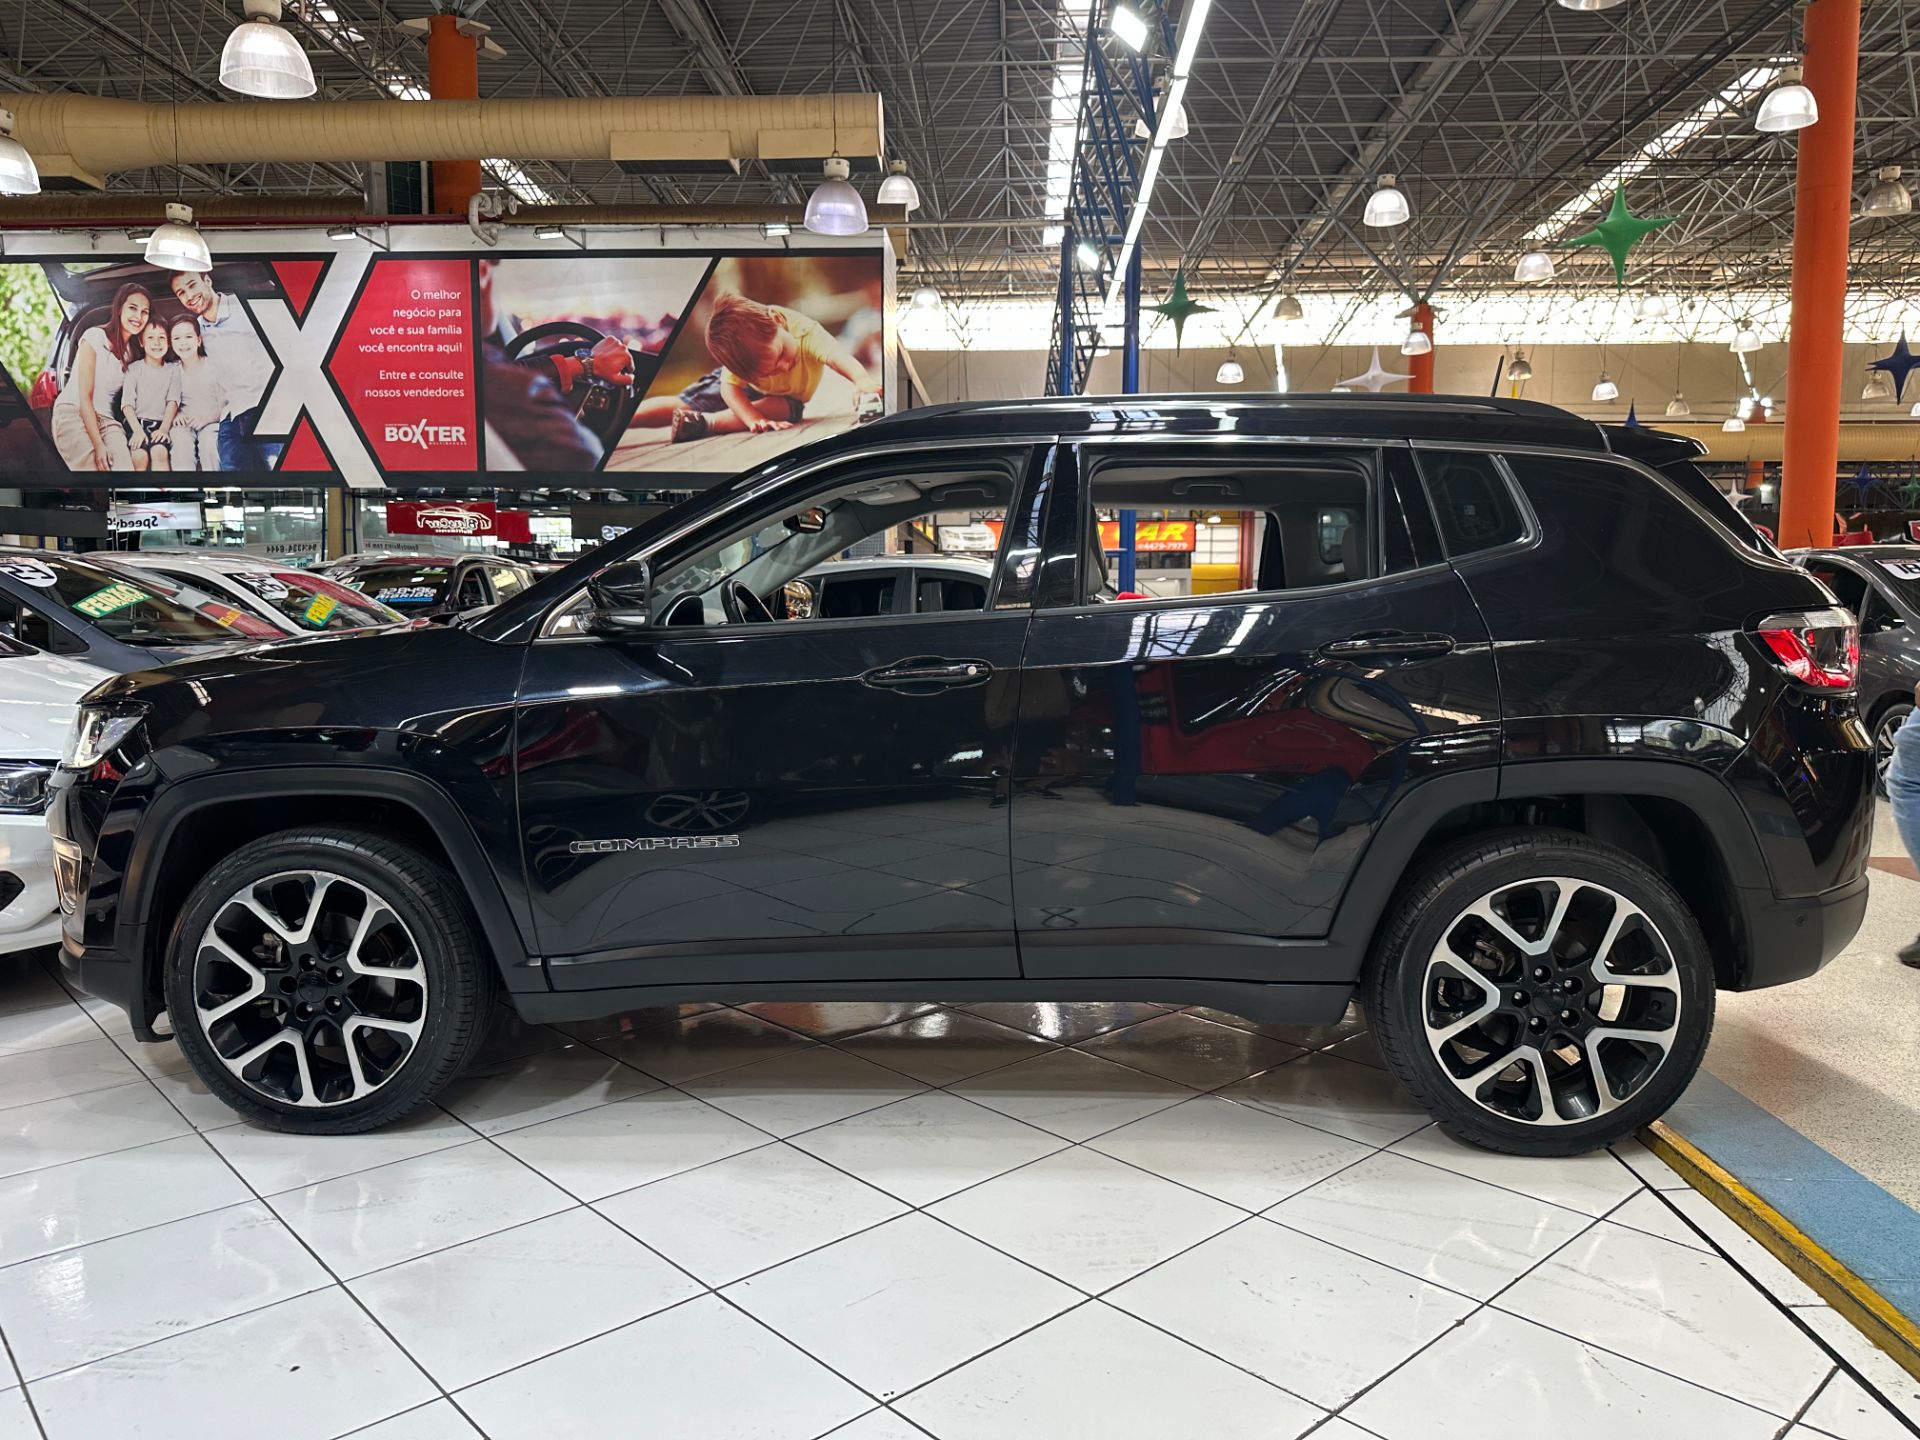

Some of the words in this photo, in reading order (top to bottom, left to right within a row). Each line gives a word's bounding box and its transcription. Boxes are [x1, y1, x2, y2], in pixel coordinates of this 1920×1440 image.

[411, 289, 421, 300] O
[423, 289, 462, 300] melhor
[393, 307, 436, 319] negócio
[438, 309, 462, 319] para
[369, 326, 395, 335] você
[397, 327, 404, 335] e
[406, 327, 425, 335] sua
[427, 325, 462, 335] família
[358, 343, 384, 352] você
[386, 344, 434, 352] encontra
[436, 343, 462, 354] aqui!
[379, 370, 407, 380] Entre
[409, 372, 416, 380] e
[418, 369, 464, 380] consulte
[365, 389, 401, 398] nossos
[403, 387, 465, 398] vendedores
[384, 418, 467, 450] BOXTER
[569, 834, 740, 854] COMPASS
